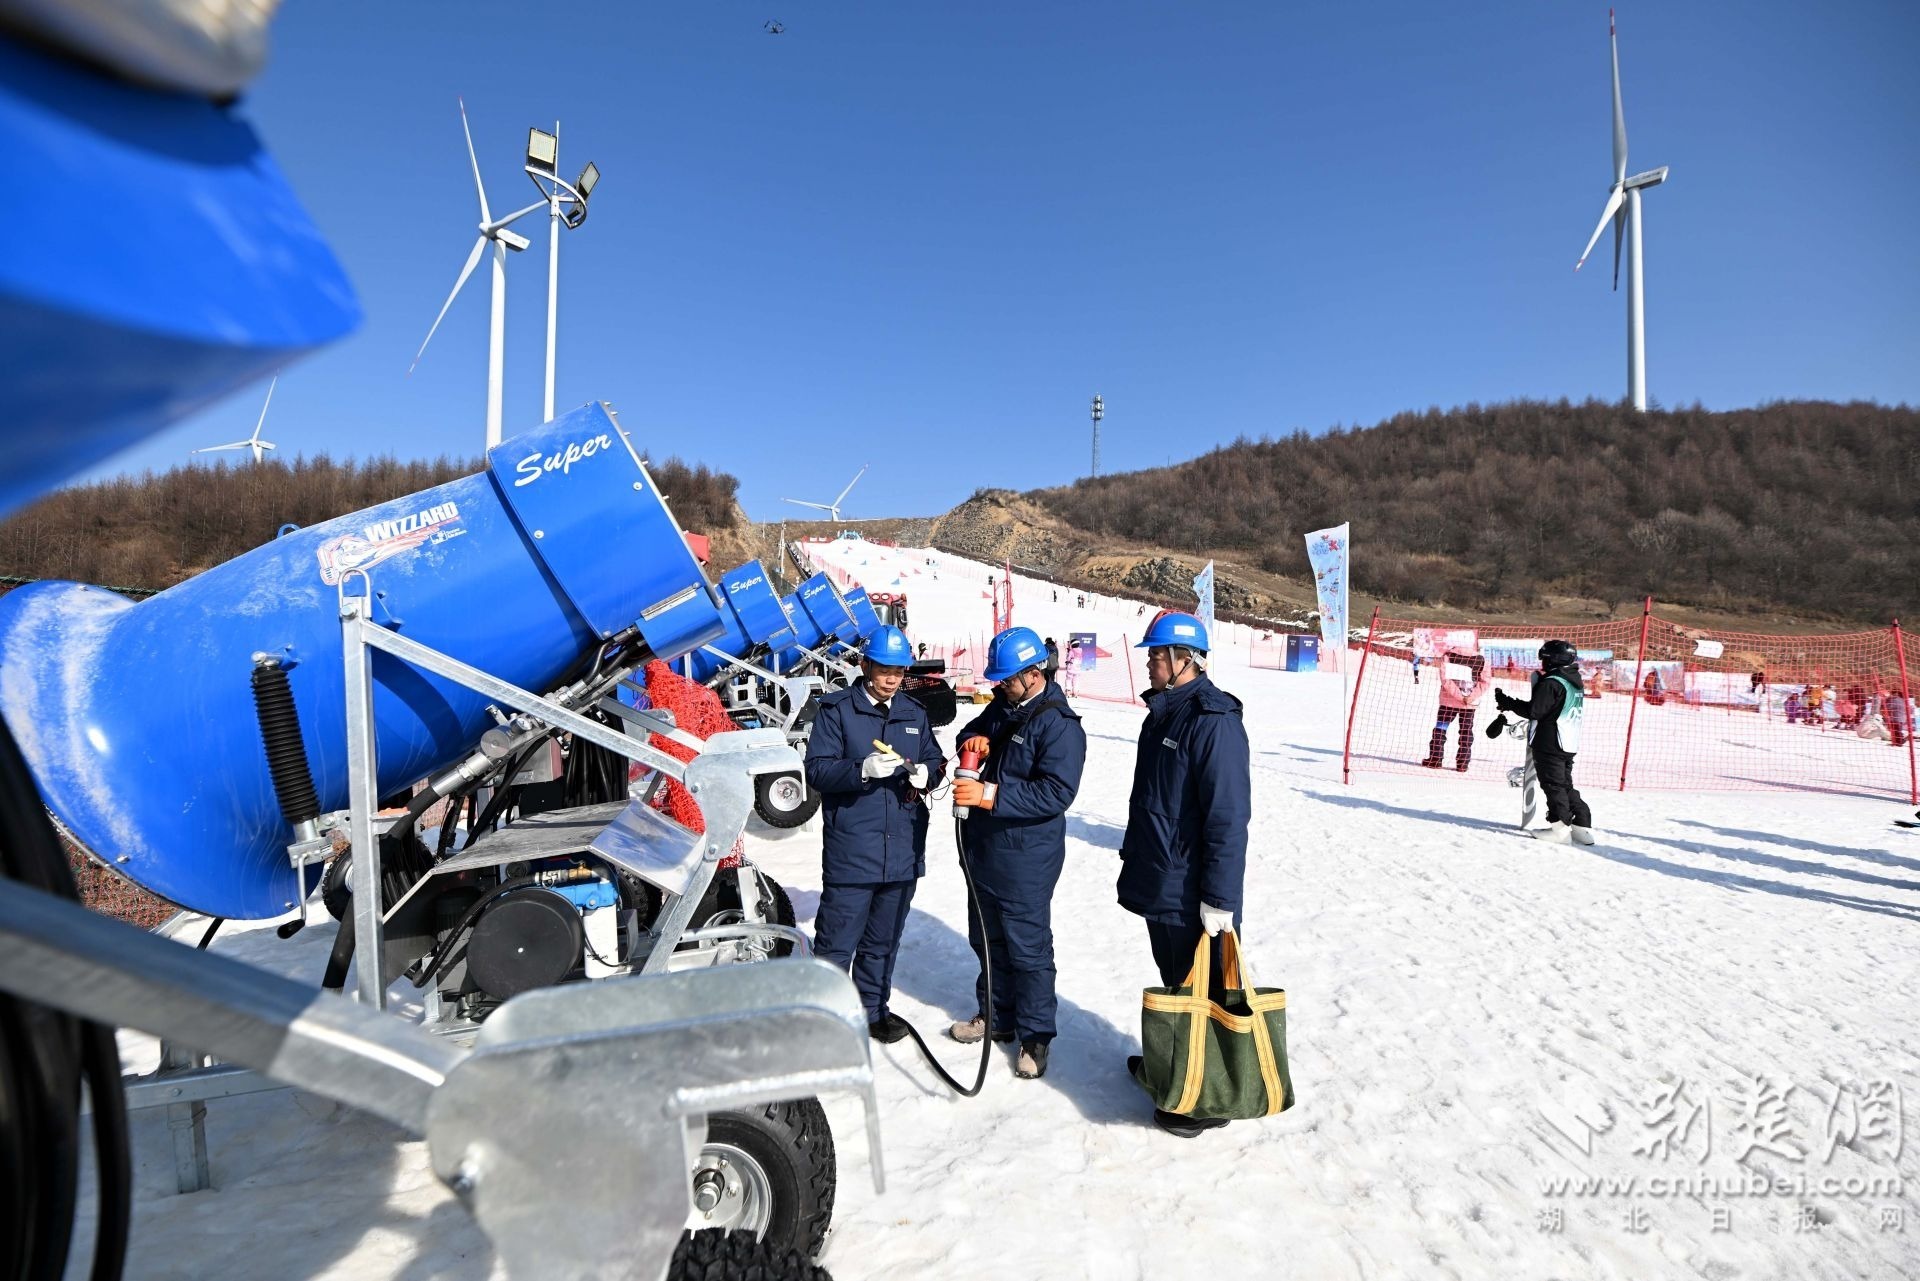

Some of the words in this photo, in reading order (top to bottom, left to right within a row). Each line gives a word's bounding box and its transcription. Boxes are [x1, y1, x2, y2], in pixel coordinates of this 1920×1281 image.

[514, 434, 612, 487] Super
[364, 501, 459, 542] WIZZARD
[730, 576, 763, 594] Super
[803, 583, 827, 599] Super
